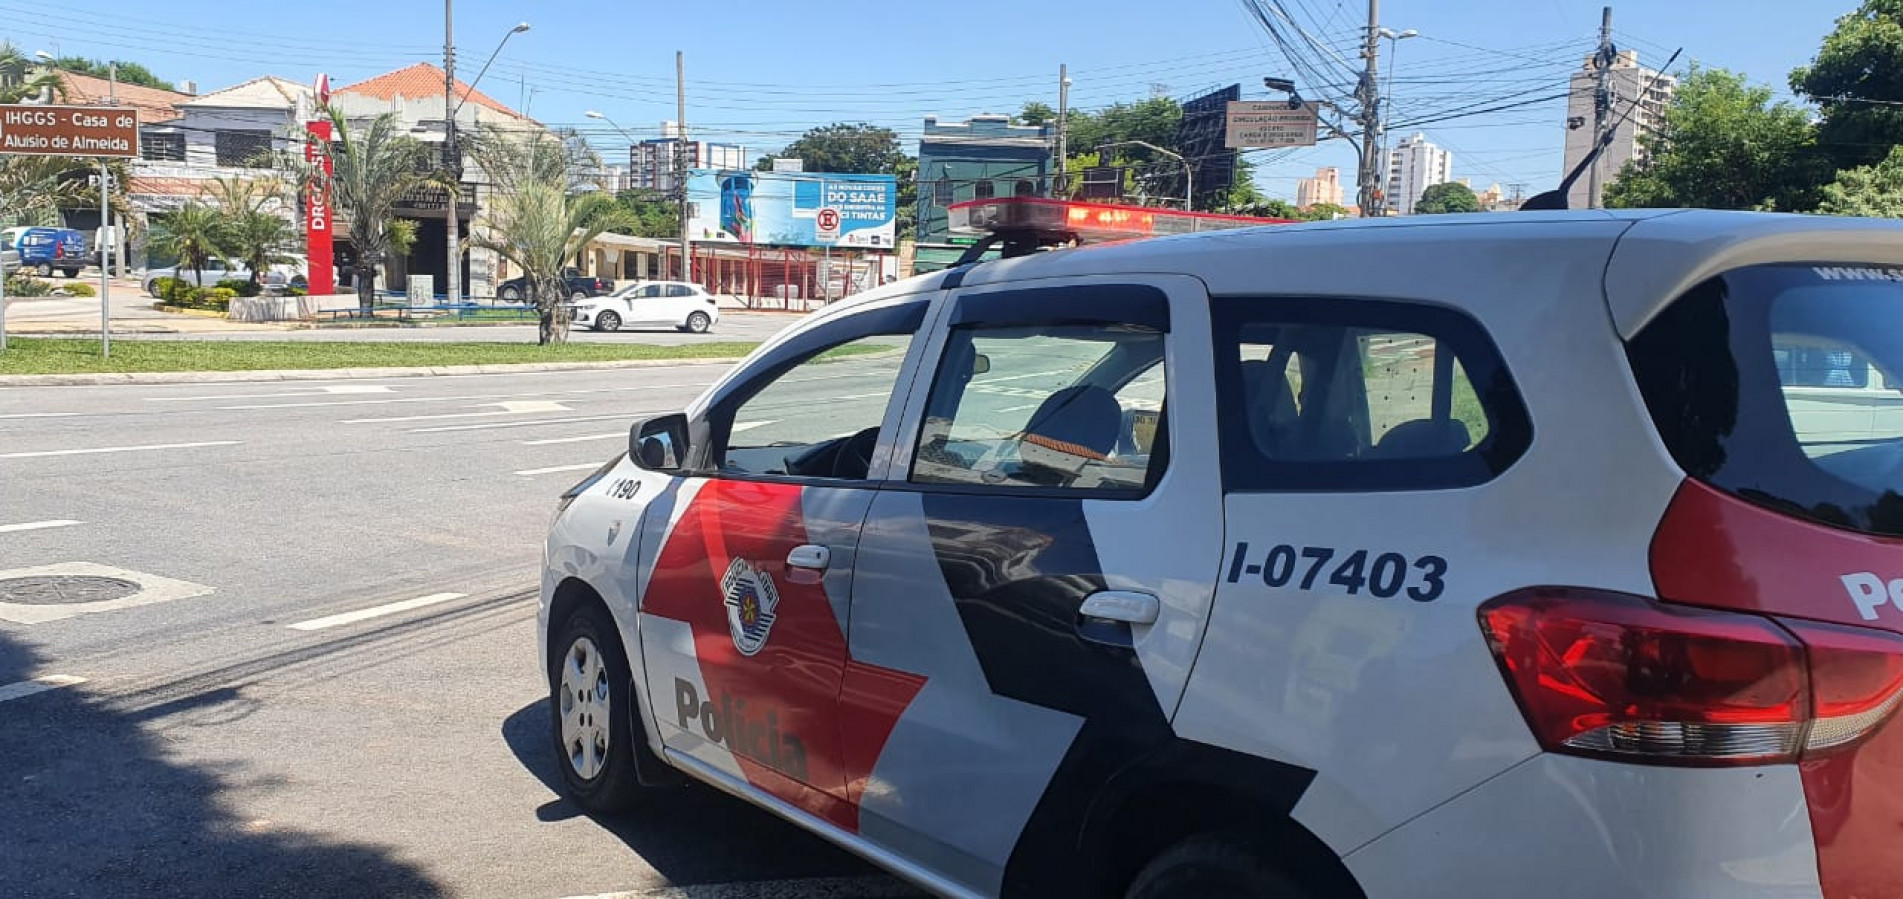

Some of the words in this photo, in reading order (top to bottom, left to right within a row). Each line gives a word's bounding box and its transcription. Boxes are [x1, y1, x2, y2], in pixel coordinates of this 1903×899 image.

[5, 111, 56, 126] IHGGS
[72, 112, 108, 127] Casa
[115, 114, 133, 128] de
[51, 135, 69, 149] de
[72, 136, 129, 151] Almeida
[311, 143, 325, 230] DROSI
[828, 191, 847, 203] DO
[849, 192, 886, 203] SAAE
[851, 211, 886, 220] TINTAS
[1812, 266, 1903, 281] www.s
[612, 479, 642, 499] 190
[1227, 541, 1448, 603] I-07403
